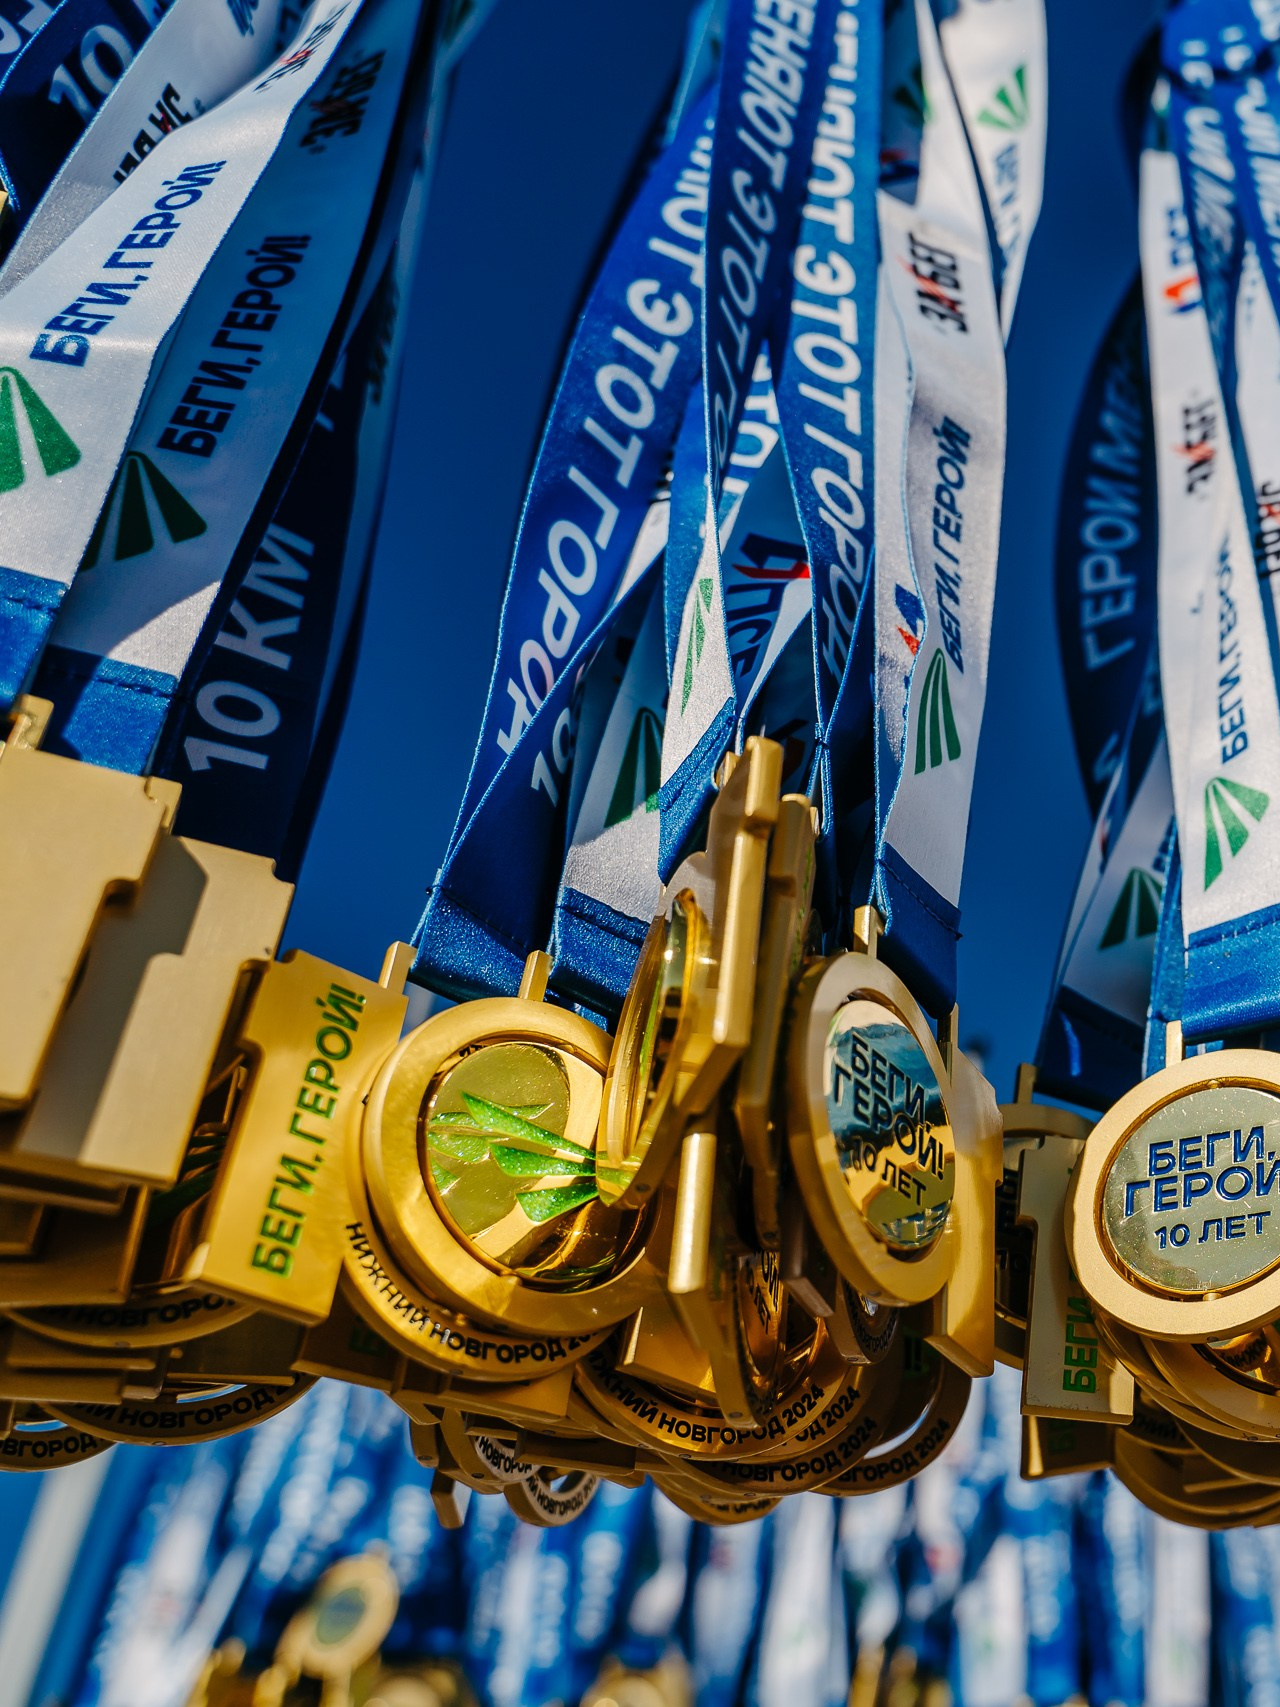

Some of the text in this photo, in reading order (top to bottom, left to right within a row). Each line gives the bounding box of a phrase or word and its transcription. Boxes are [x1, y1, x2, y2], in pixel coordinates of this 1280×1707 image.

[790, 245, 862, 435] ЭТОТ
[583, 279, 694, 489] ЭТОТ
[184, 522, 315, 772] 10 КМ
[833, 1063, 944, 1181] ГЕРОЙ!
[1148, 1125, 1276, 1178] БЕГИ,
[880, 1161, 926, 1205] ЛЕТ
[1154, 1211, 1271, 1250] 10 ЛЕТ
[346, 1221, 429, 1334] НИЖНИЙ
[429, 1322, 567, 1364] НОВГОРОД
[118, 1387, 272, 1429] НОВГОРОД
[783, 1384, 825, 1428] 2024
[820, 1386, 860, 1428] 2024
[837, 1416, 877, 1462] 2024
[915, 1418, 951, 1459] 2024
